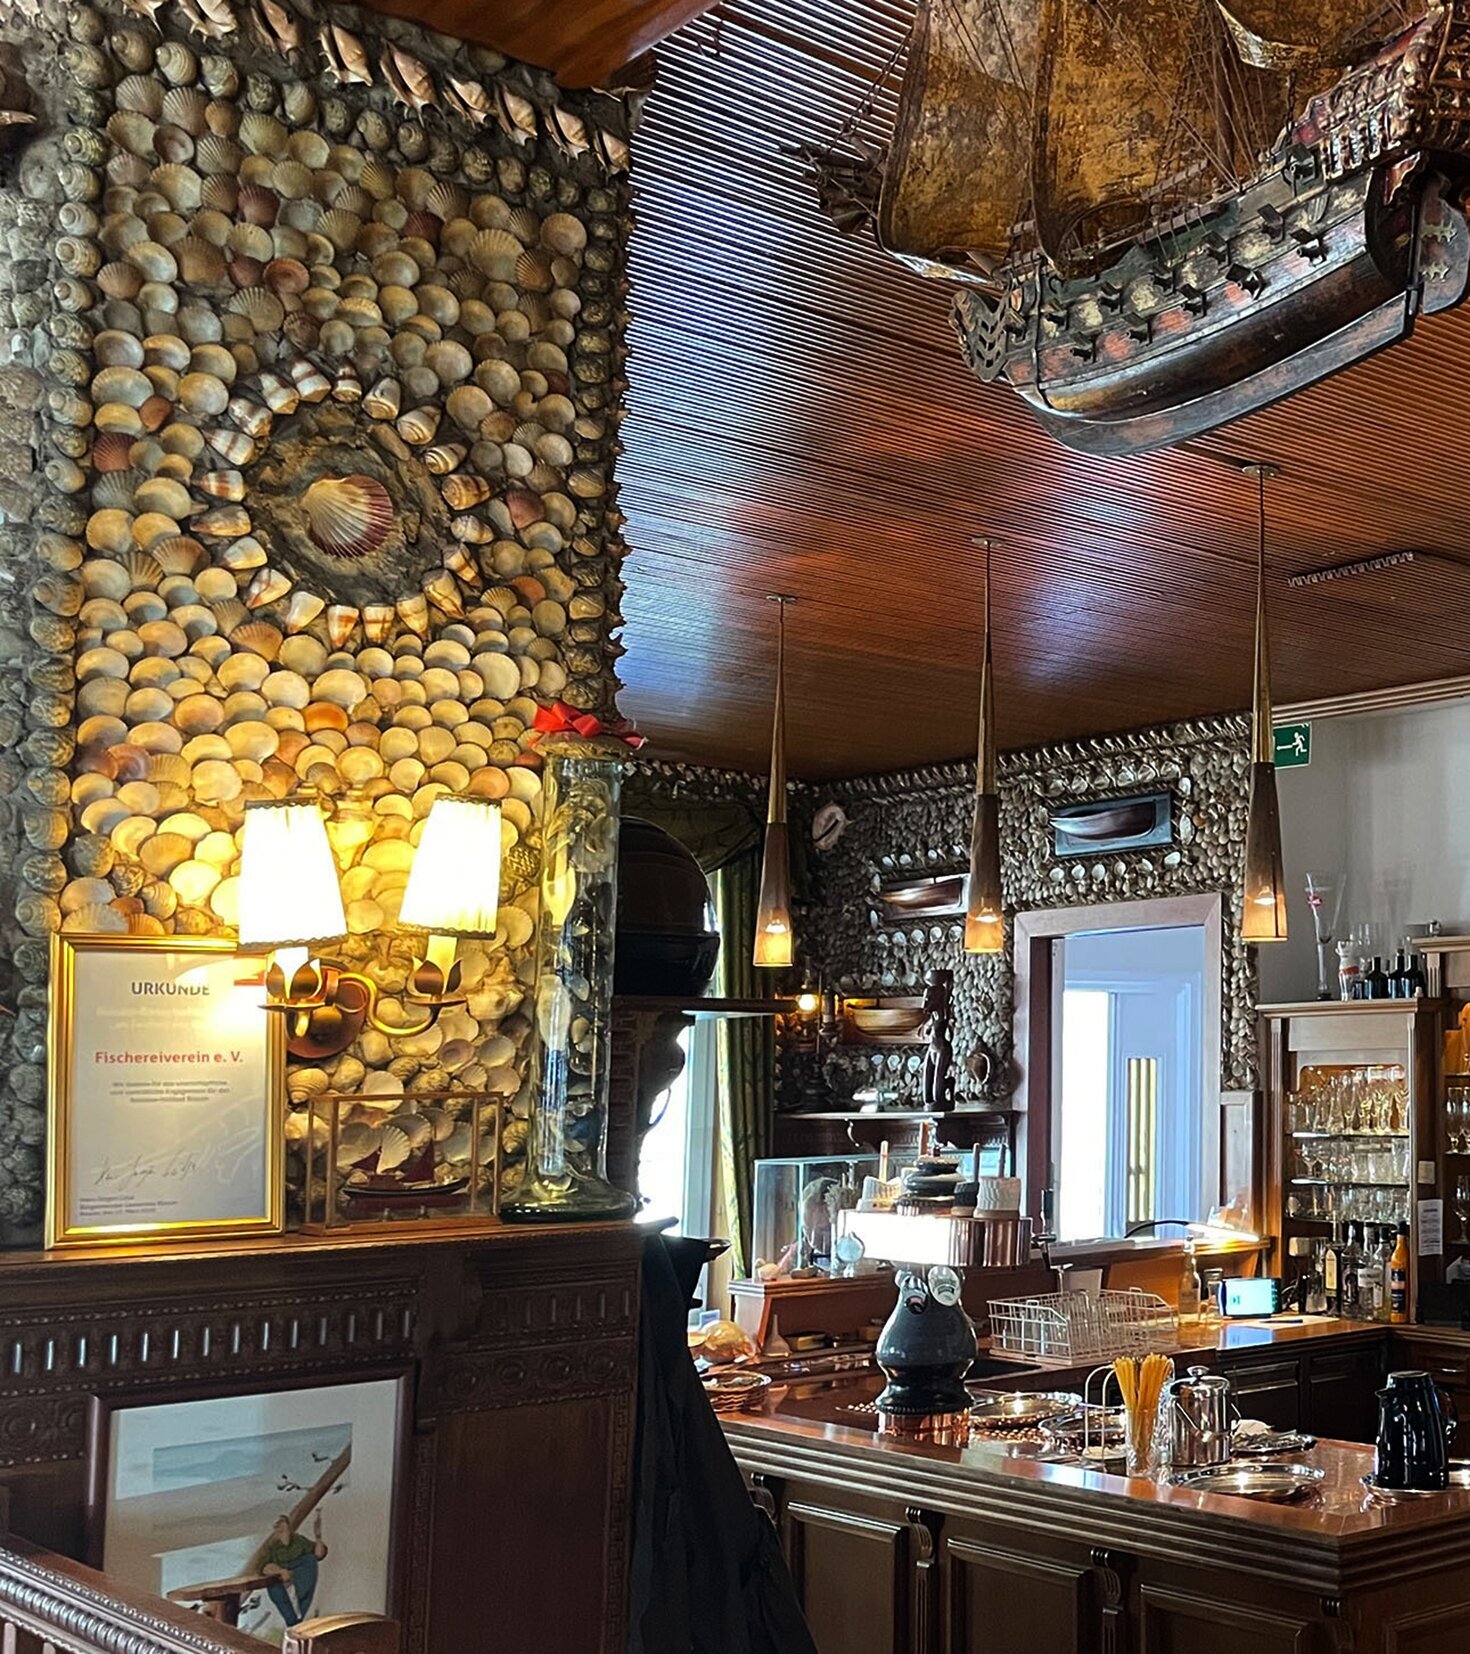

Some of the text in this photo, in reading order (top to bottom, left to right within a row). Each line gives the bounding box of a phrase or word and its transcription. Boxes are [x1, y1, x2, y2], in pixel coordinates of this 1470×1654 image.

[131, 981, 210, 996] URKUNDE
[95, 1051, 244, 1064] Fischereiverein e. V.
